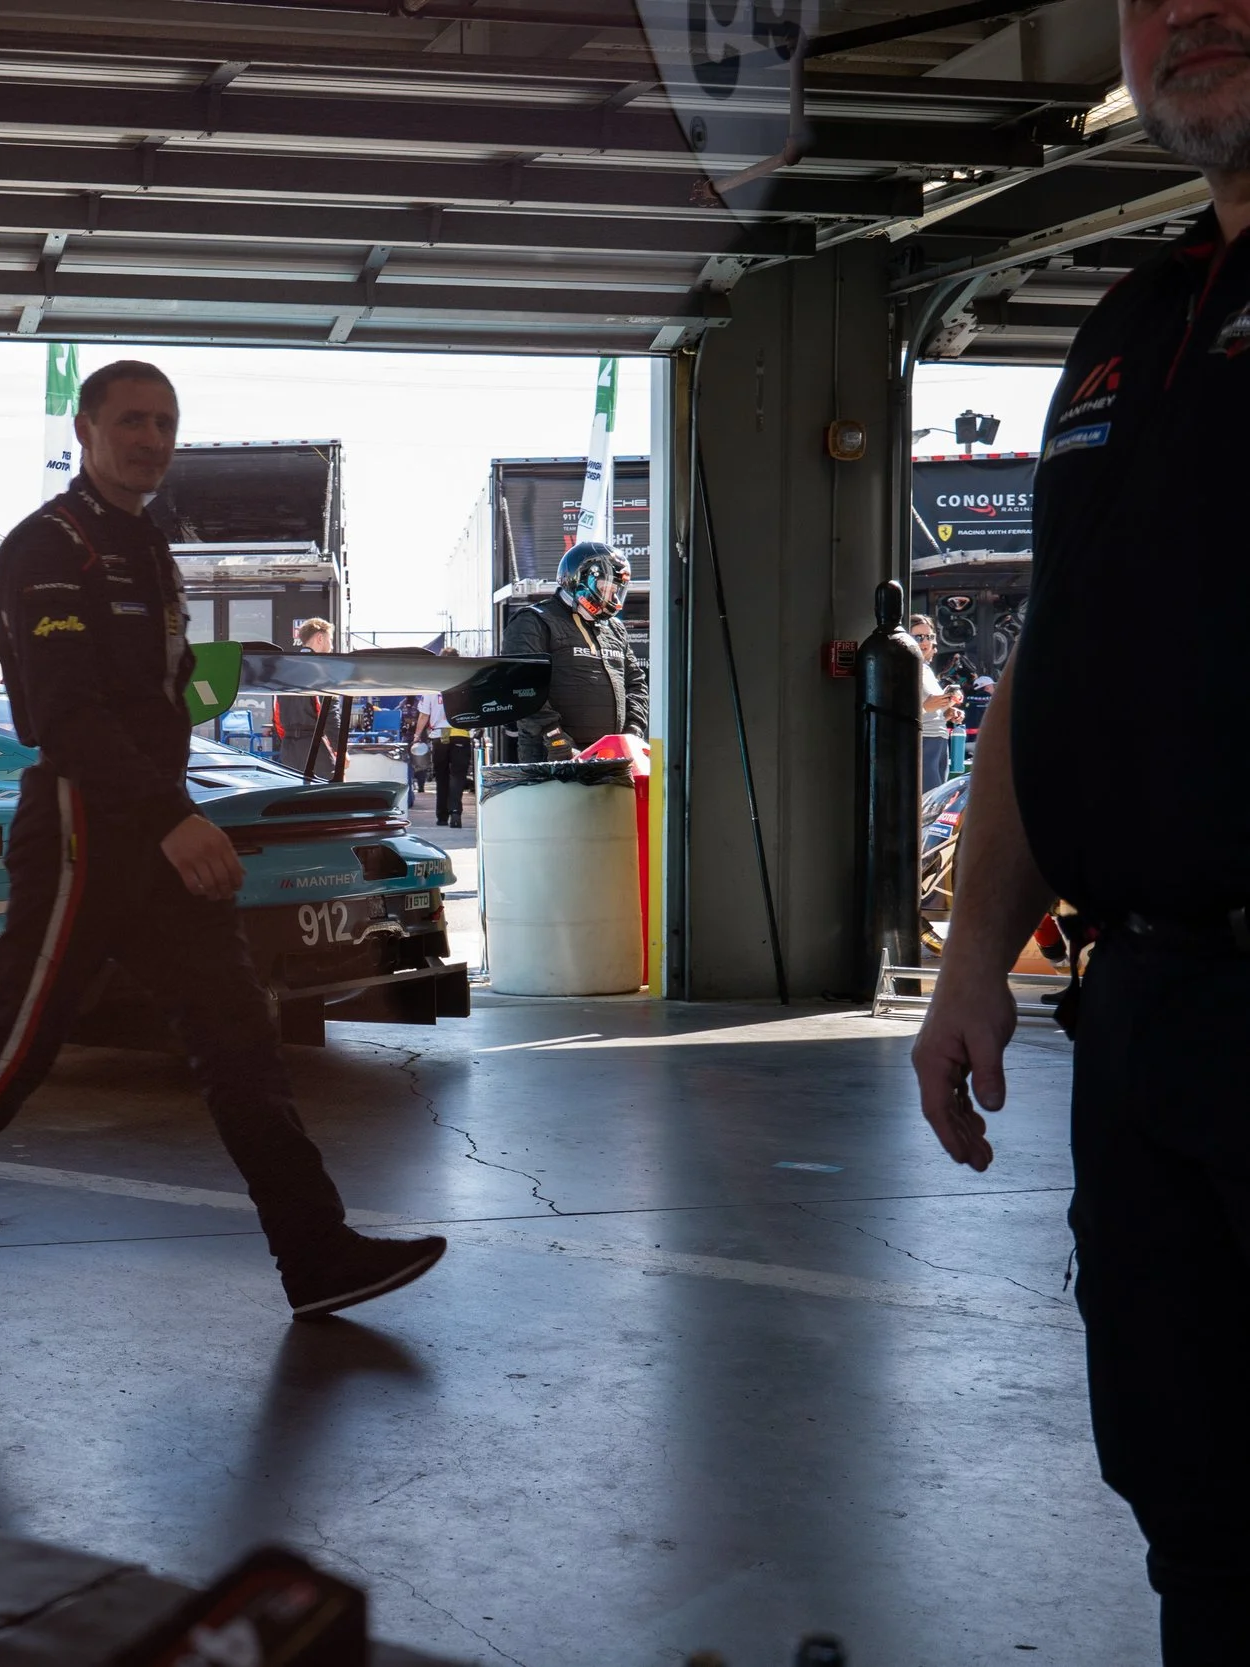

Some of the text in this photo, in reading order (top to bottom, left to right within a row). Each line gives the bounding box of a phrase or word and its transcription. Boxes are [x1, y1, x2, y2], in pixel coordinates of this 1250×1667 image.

[562, 498, 648, 509] POCHE
[562, 513, 577, 521] 911
[957, 527, 986, 536] RACING
[987, 526, 1006, 535] WITH
[837, 642, 855, 650] FIRE
[573, 646, 625, 660] RELTIME
[496, 704, 513, 712] Shaft
[297, 873, 358, 889] MANTHEY
[299, 901, 352, 946] 912
